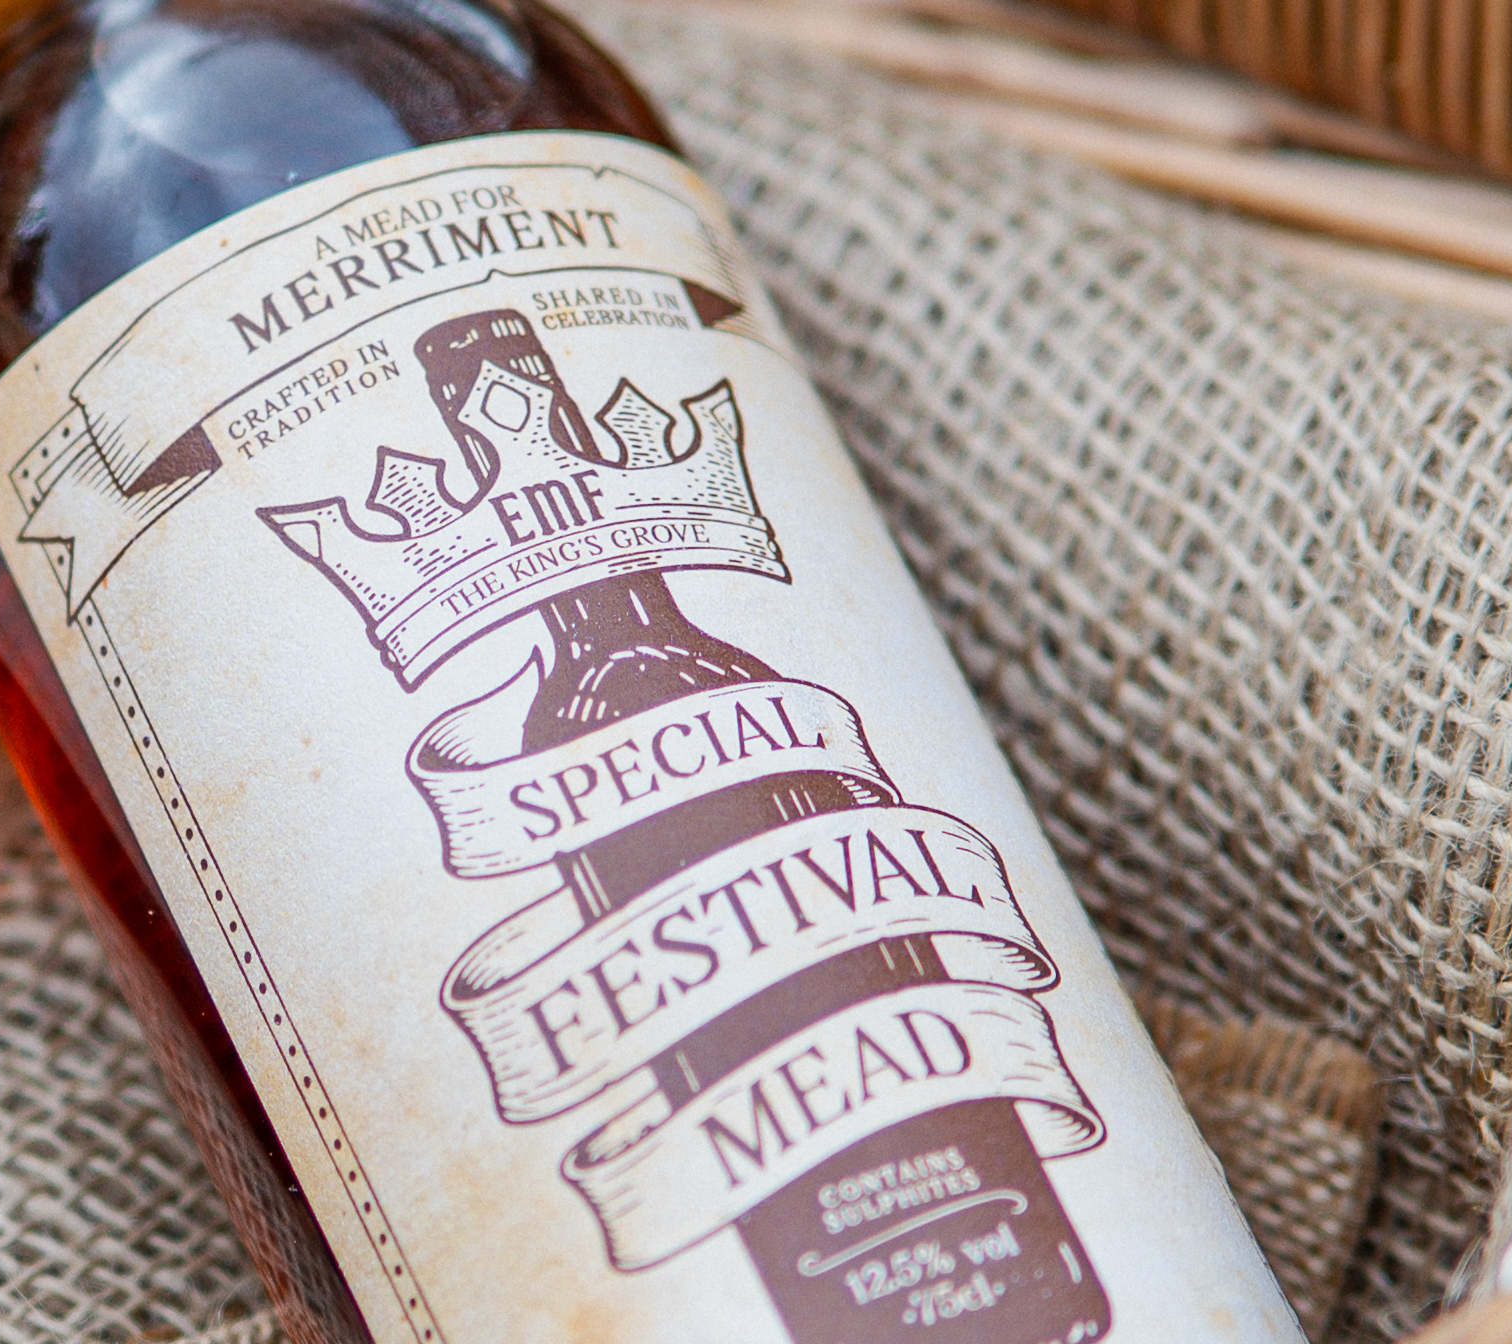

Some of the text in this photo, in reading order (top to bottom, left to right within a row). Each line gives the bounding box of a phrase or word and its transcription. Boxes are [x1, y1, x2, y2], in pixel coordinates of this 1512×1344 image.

[315, 185, 522, 261] A MEAD FOR
[227, 209, 624, 355] MERRIMENT
[532, 288, 678, 311] SHARED IN
[542, 309, 690, 330] CELEBRATION
[228, 339, 390, 441] CRAFTED IN
[237, 361, 401, 461] TRADITION
[488, 469, 605, 546] EMF
[440, 523, 710, 617] THE KING'S GROVE
[509, 696, 826, 844] SPECIAL
[525, 828, 987, 1077] FESTIVAL
[699, 1010, 972, 1189] MEAD
[818, 1145, 965, 1208] CONTAINS
[822, 1166, 981, 1235] SULPHITES
[960, 1221, 1021, 1266] vol
